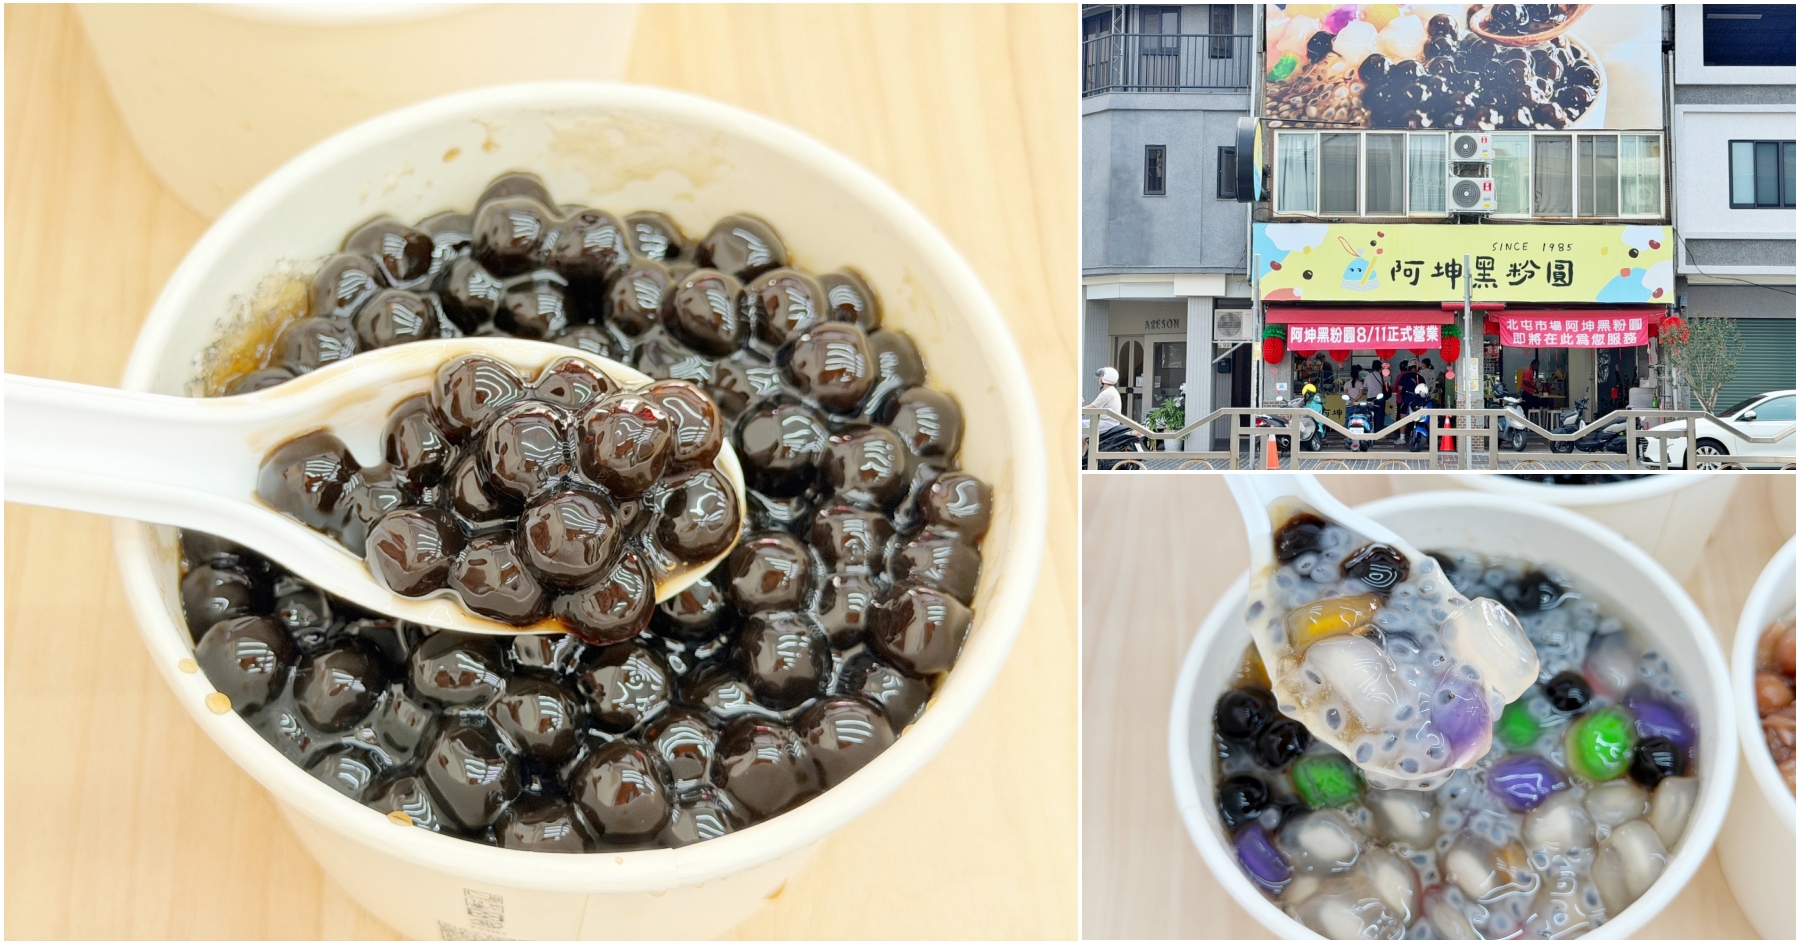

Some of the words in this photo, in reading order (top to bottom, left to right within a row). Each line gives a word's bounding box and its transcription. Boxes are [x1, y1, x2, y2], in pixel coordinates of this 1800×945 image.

[1492, 242, 1528, 252] SINCE
[1542, 242, 1574, 252] 1985
[1391, 255, 1574, 290] 阿坤黑粉圓
[1144, 318, 1180, 330] ARESON
[1506, 317, 1643, 332] 北屯市場阿坤黑粉圓
[1290, 325, 1439, 344] 阿坤黑粉圓8/11正式營業
[1512, 331, 1638, 346] 即將在此為您服務
